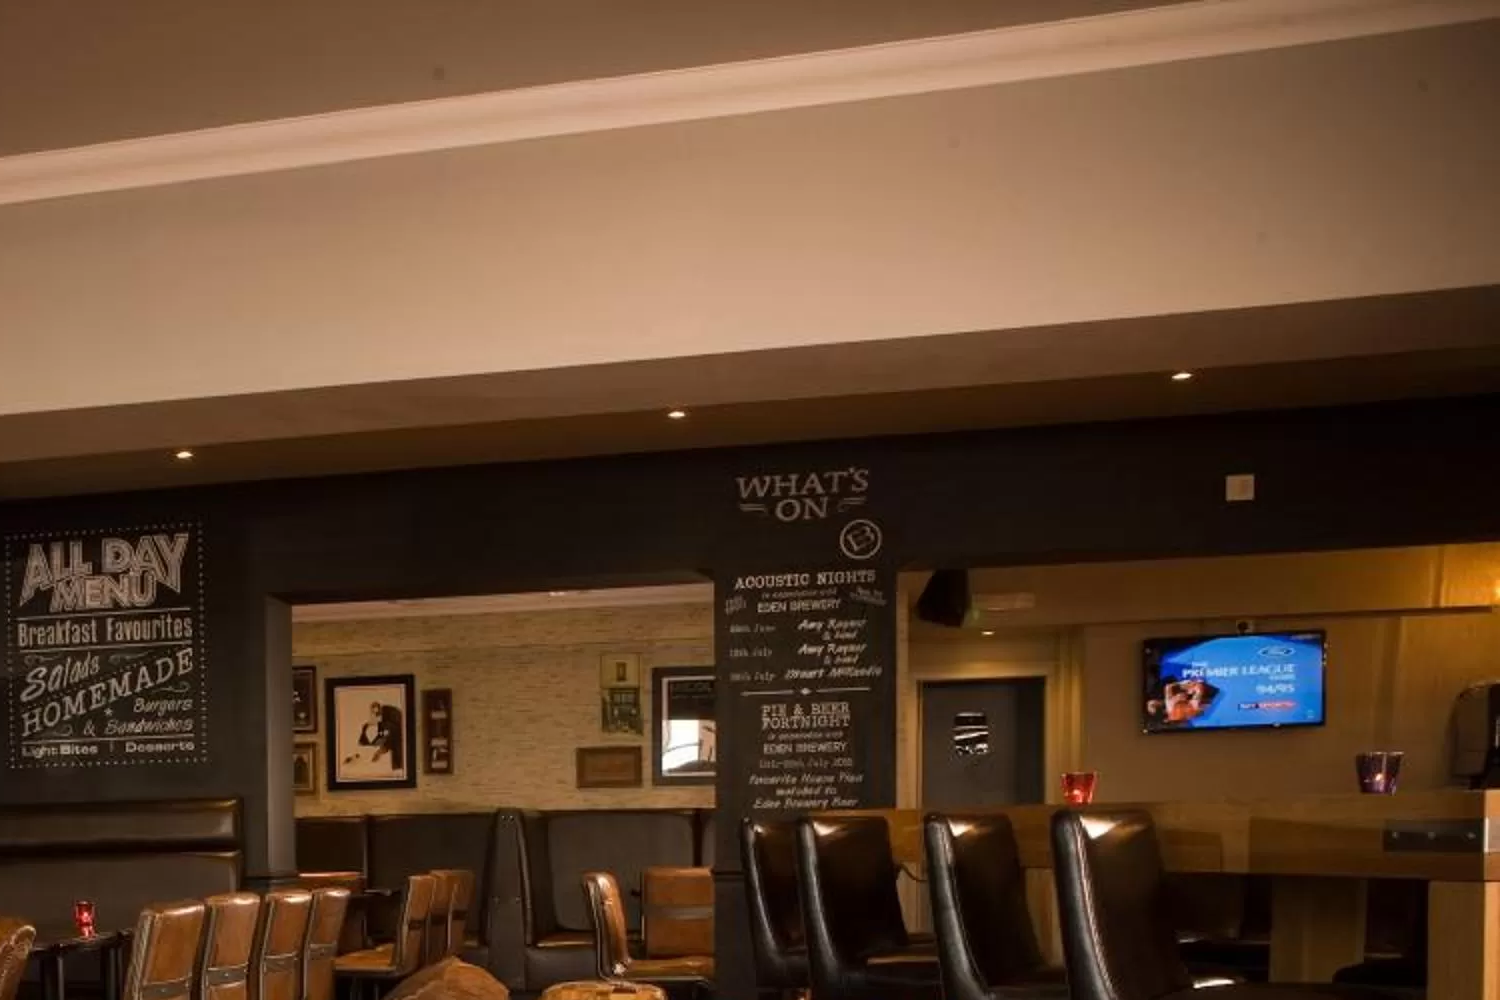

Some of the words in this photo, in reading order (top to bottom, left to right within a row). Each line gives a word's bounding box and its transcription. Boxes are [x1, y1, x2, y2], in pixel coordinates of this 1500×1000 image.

[736, 467, 870, 500] WHAT'S
[774, 497, 829, 522] ON
[19, 539, 94, 608] ALL
[101, 532, 190, 595] DAY
[734, 572, 810, 590] ACOUSTIC
[817, 570, 877, 586] NIGHTS
[49, 570, 158, 613] MENU
[756, 601, 787, 613] EDEN
[17, 618, 97, 648] Breakfast
[106, 613, 194, 643] Favourites
[19, 652, 101, 703] Salads
[1181, 666, 1239, 679] PREMIER
[1241, 662, 1296, 676] LEAGUE
[20, 648, 194, 738] HOMEMADE
[133, 696, 194, 716] Burgers
[760, 703, 787, 718] PIE
[792, 703, 805, 717] &
[811, 701, 850, 716] BEER
[83, 720, 96, 737] &
[104, 718, 194, 737] Sandwiches
[761, 714, 851, 730] FORTNIGHT
[60, 743, 99, 756] Bites
[125, 740, 195, 754] Desserts
